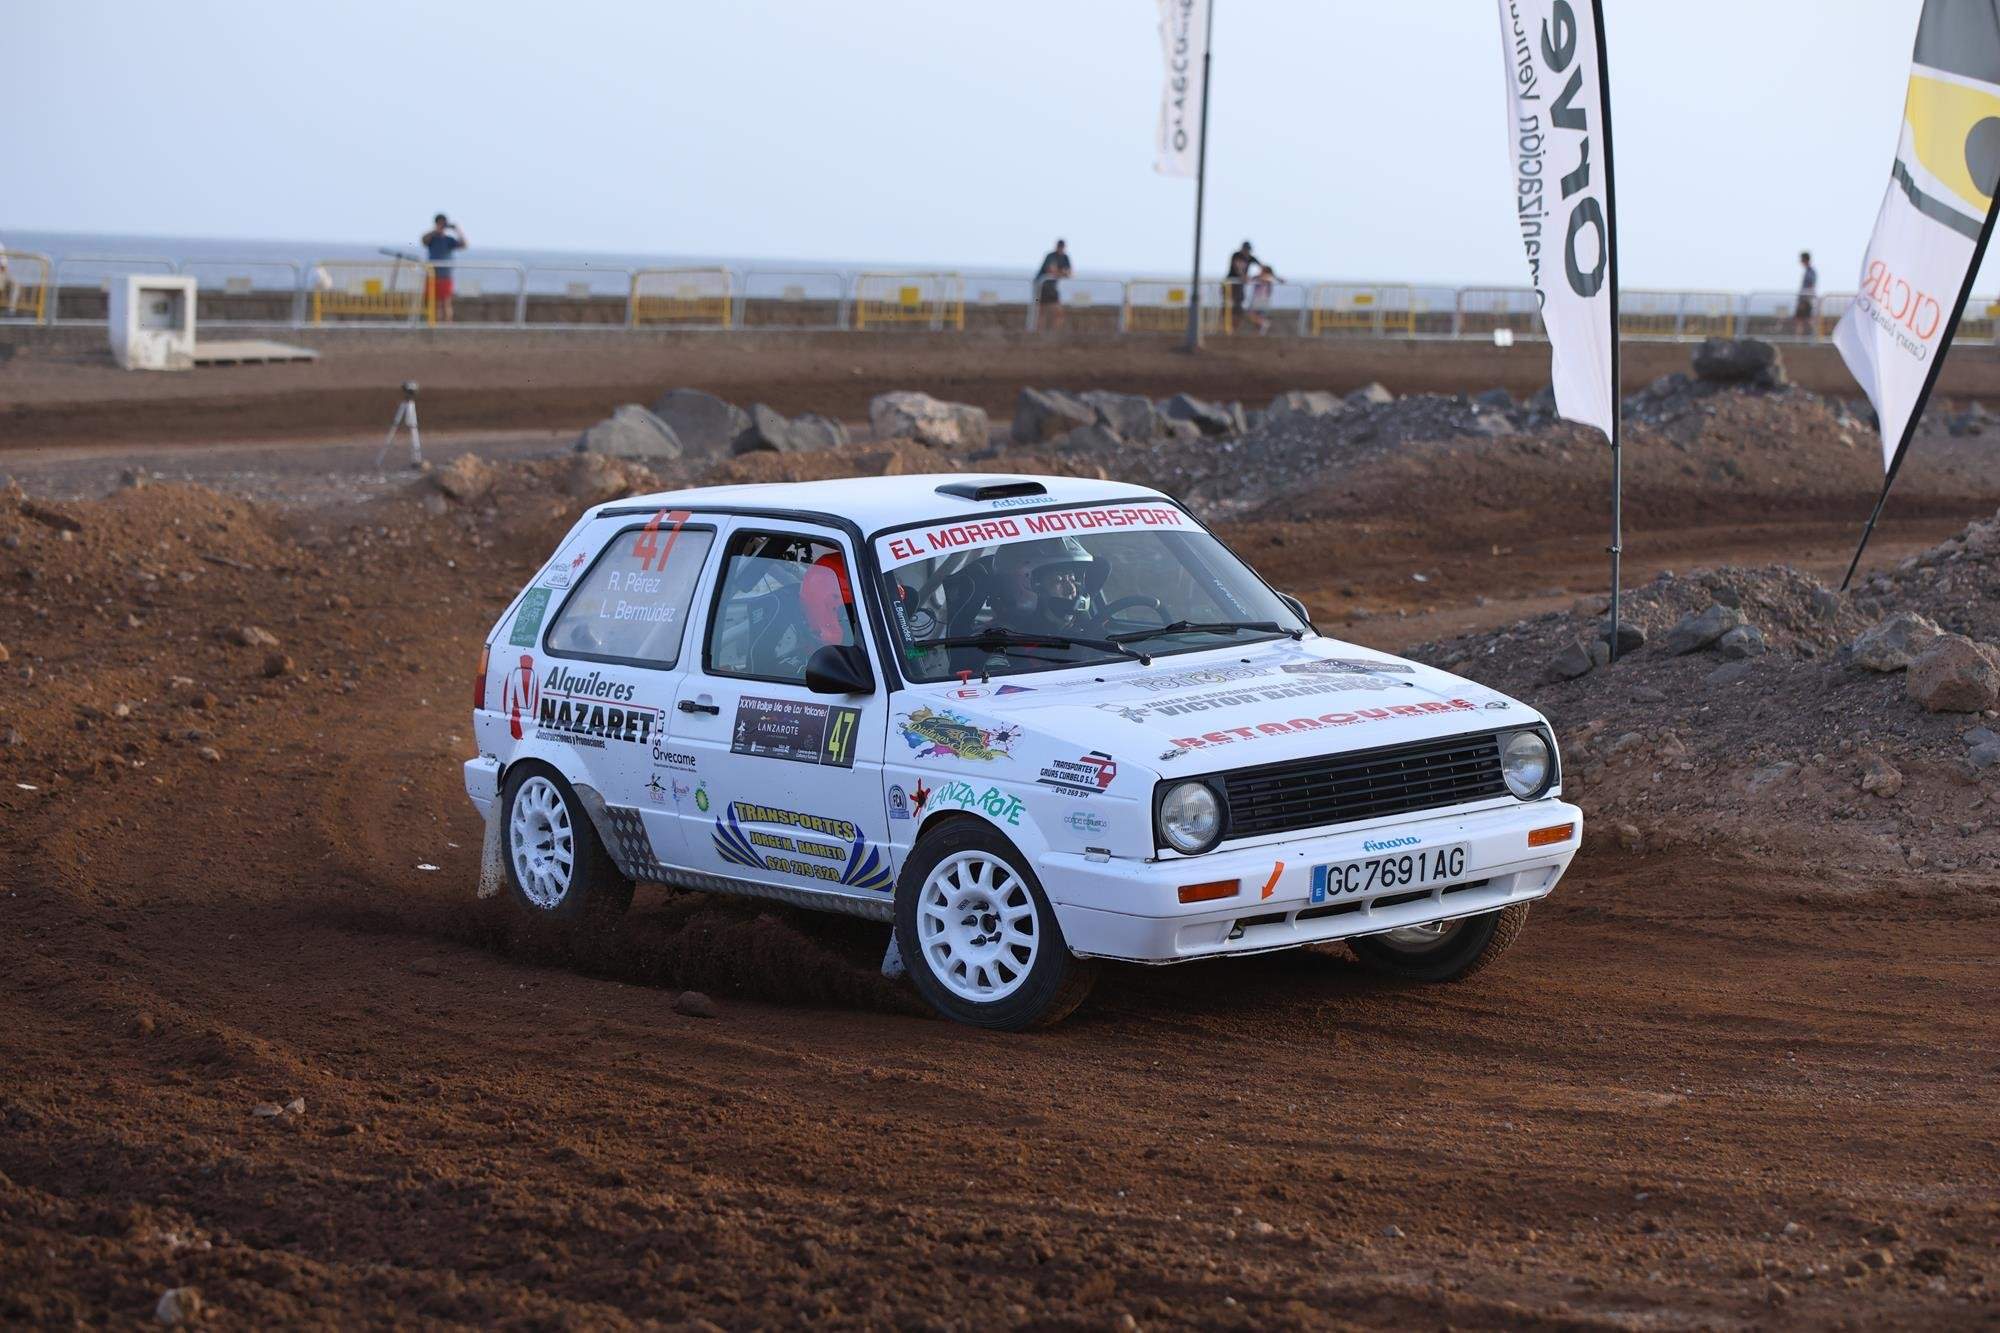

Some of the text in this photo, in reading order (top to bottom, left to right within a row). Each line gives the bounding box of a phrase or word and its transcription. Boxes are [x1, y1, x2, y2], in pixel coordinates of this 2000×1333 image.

[632, 508, 693, 572] 47
[888, 508, 1184, 560] EL MORRO MOTORSPORT
[607, 570, 661, 593] R. Pérez
[600, 600, 676, 622] L. Bermúdez
[544, 666, 636, 701] Alquileres
[784, 703, 792, 713] de
[1155, 692, 1262, 716] VICTOR
[538, 698, 655, 745] NAZARET
[757, 722, 799, 735] LANZAROTE
[828, 711, 855, 762] 47
[652, 747, 696, 766] Orvecame
[1052, 759, 1099, 775] TRANSPORTES Y
[1058, 771, 1085, 783] CURBELO
[1055, 786, 1067, 795] 640
[1067, 788, 1079, 797] 269
[733, 801, 857, 843] TRANSPORTES
[750, 831, 847, 861] JORGE M. BARRETO
[1362, 835, 1422, 852] Ainara
[765, 855, 840, 882] 620 279 328
